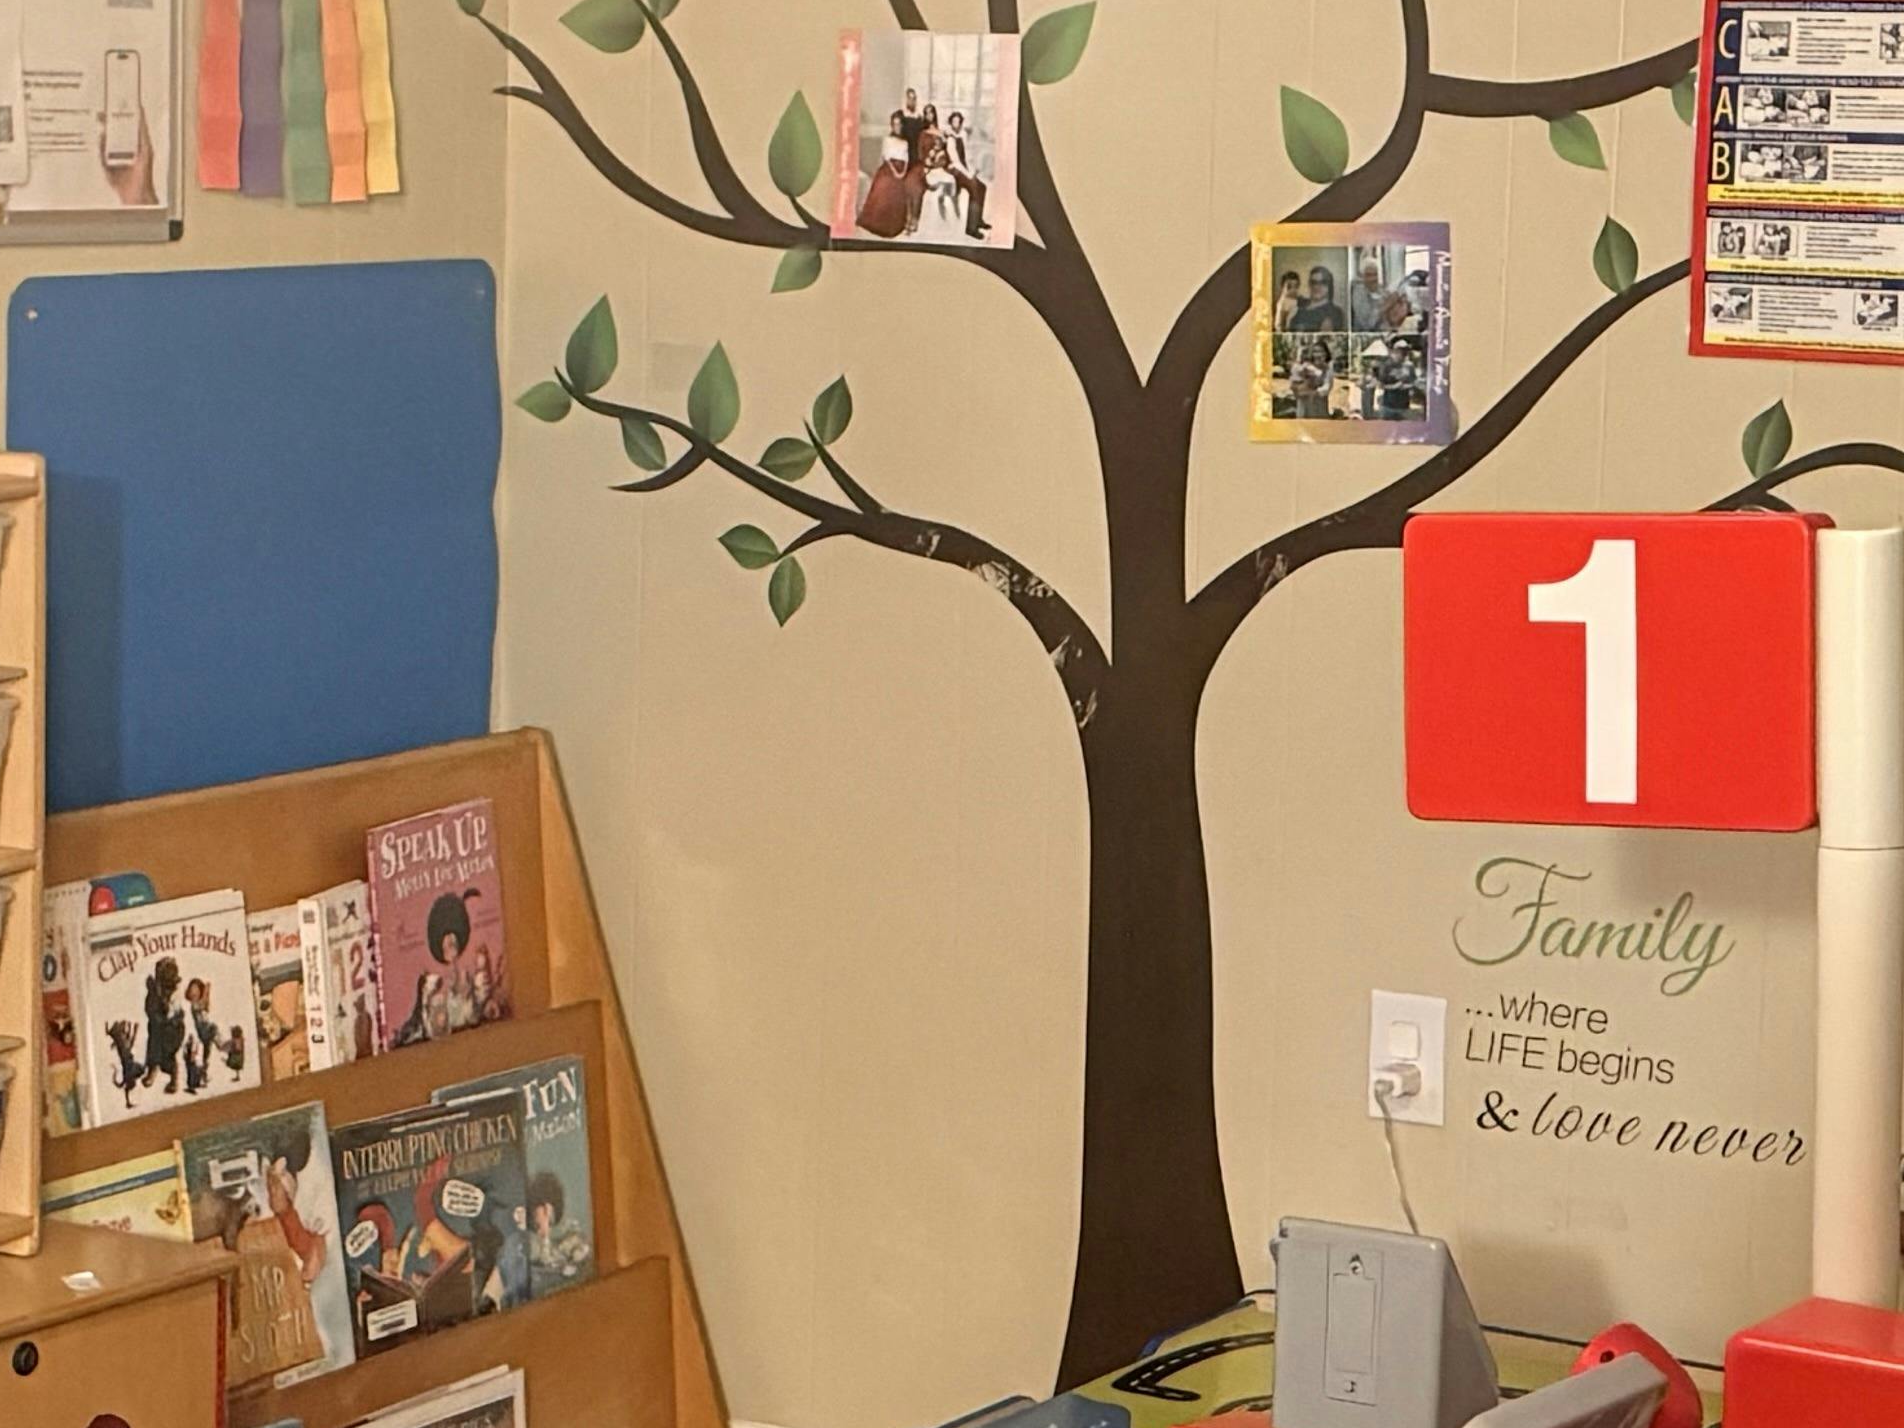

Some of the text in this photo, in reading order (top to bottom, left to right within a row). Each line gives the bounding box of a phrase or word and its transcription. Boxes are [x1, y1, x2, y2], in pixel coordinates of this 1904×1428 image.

[1718, 19, 1738, 59] C
[1715, 86, 1734, 126] A
[1711, 142, 1731, 182] B
[1527, 538, 1639, 805] 1
[381, 821, 451, 879] SPEAK
[98, 949, 138, 982] Clap
[136, 929, 178, 958] Your
[181, 925, 237, 957] Hands
[1452, 857, 1737, 997] Family
[349, 941, 365, 991] 2
[1464, 993, 1609, 1035] ...where
[1465, 1027, 1676, 1086] LIFE begins
[523, 1067, 578, 1121] FUN
[342, 1113, 518, 1180] INTERRUPTING CHICKEN
[1475, 1090, 1520, 1134] &
[1531, 1091, 1643, 1148] love
[1654, 1117, 1809, 1168] never
